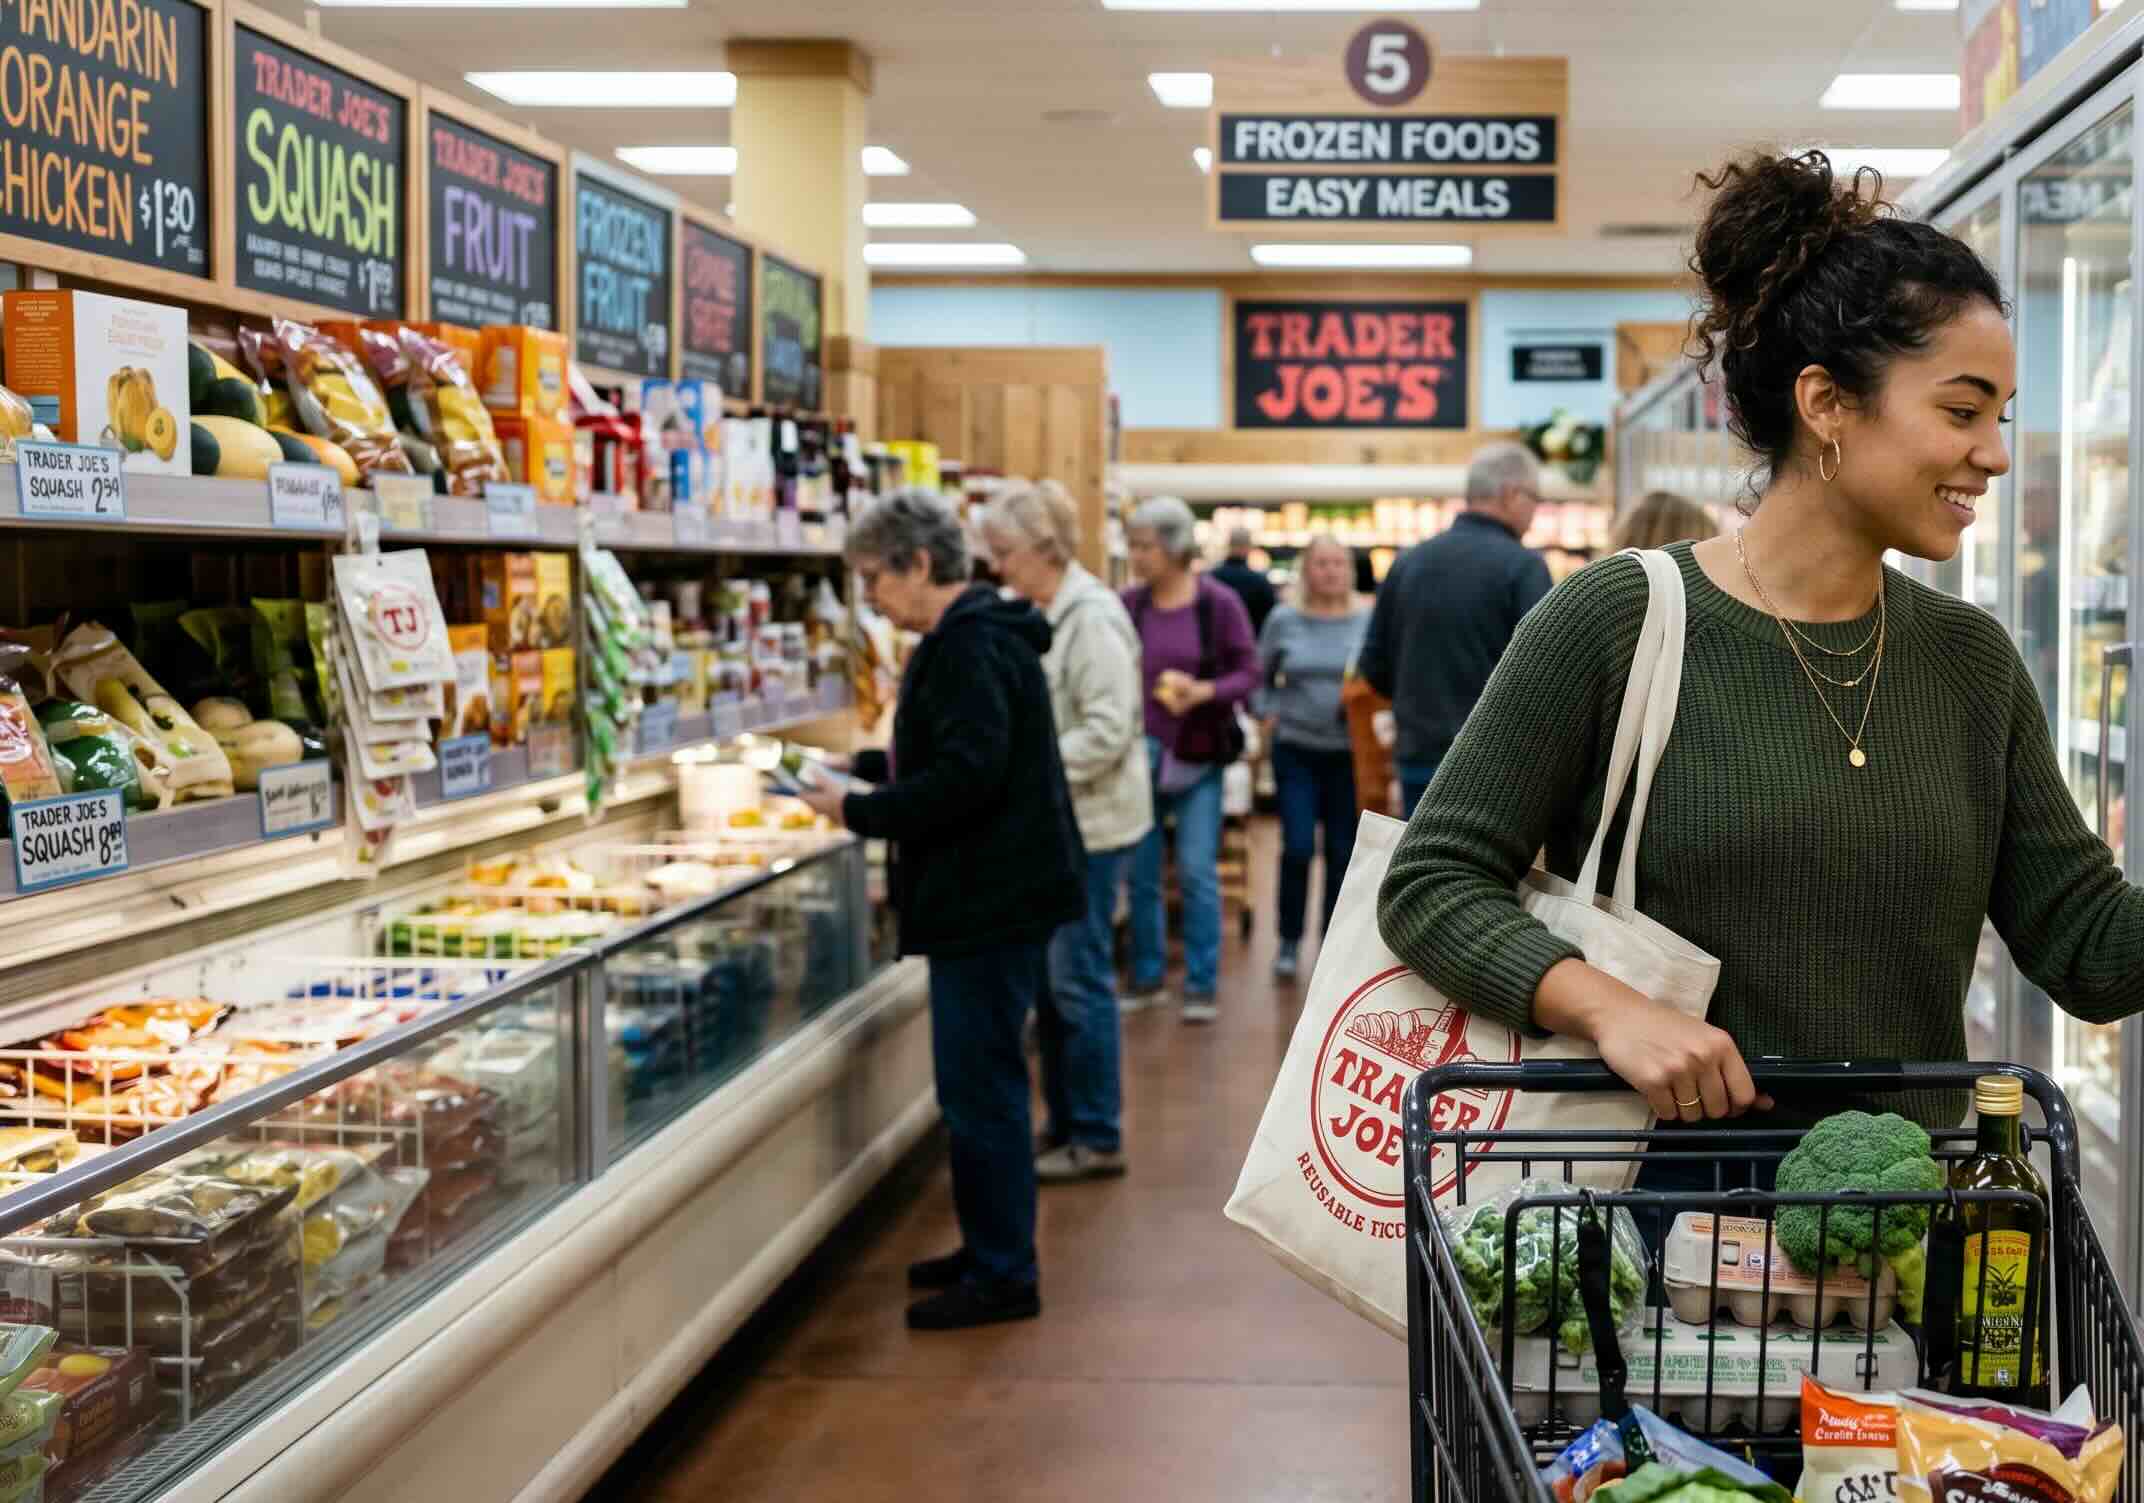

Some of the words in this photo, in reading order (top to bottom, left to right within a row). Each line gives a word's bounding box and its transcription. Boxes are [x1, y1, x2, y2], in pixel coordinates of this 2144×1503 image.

[254, 51, 335, 121] TRADER
[1364, 34, 1410, 94] 5
[0, 46, 153, 165] ORANGE
[1234, 121, 1391, 159] FROZEN
[1402, 122, 1541, 160] FOODS
[0, 138, 134, 246] HICKEN
[246, 108, 395, 258] SQUASH
[1265, 178, 1369, 216] EASY
[1377, 178, 1510, 217] MEALS
[443, 185, 537, 290] FRUIT
[584, 262, 651, 336] FRUIT
[1249, 312, 1456, 360] TRADER
[1257, 364, 1442, 420] JOE'S
[25, 450, 73, 473] TRADER
[30, 476, 84, 499] SQUASH
[383, 607, 417, 634] TJ
[21, 805, 73, 830] TRADER
[22, 825, 95, 866] SQUASH
[1331, 1047, 1481, 1130] TRAER
[1330, 1104, 1441, 1167] JOE
[1297, 1151, 1366, 1232] REUSABLE
